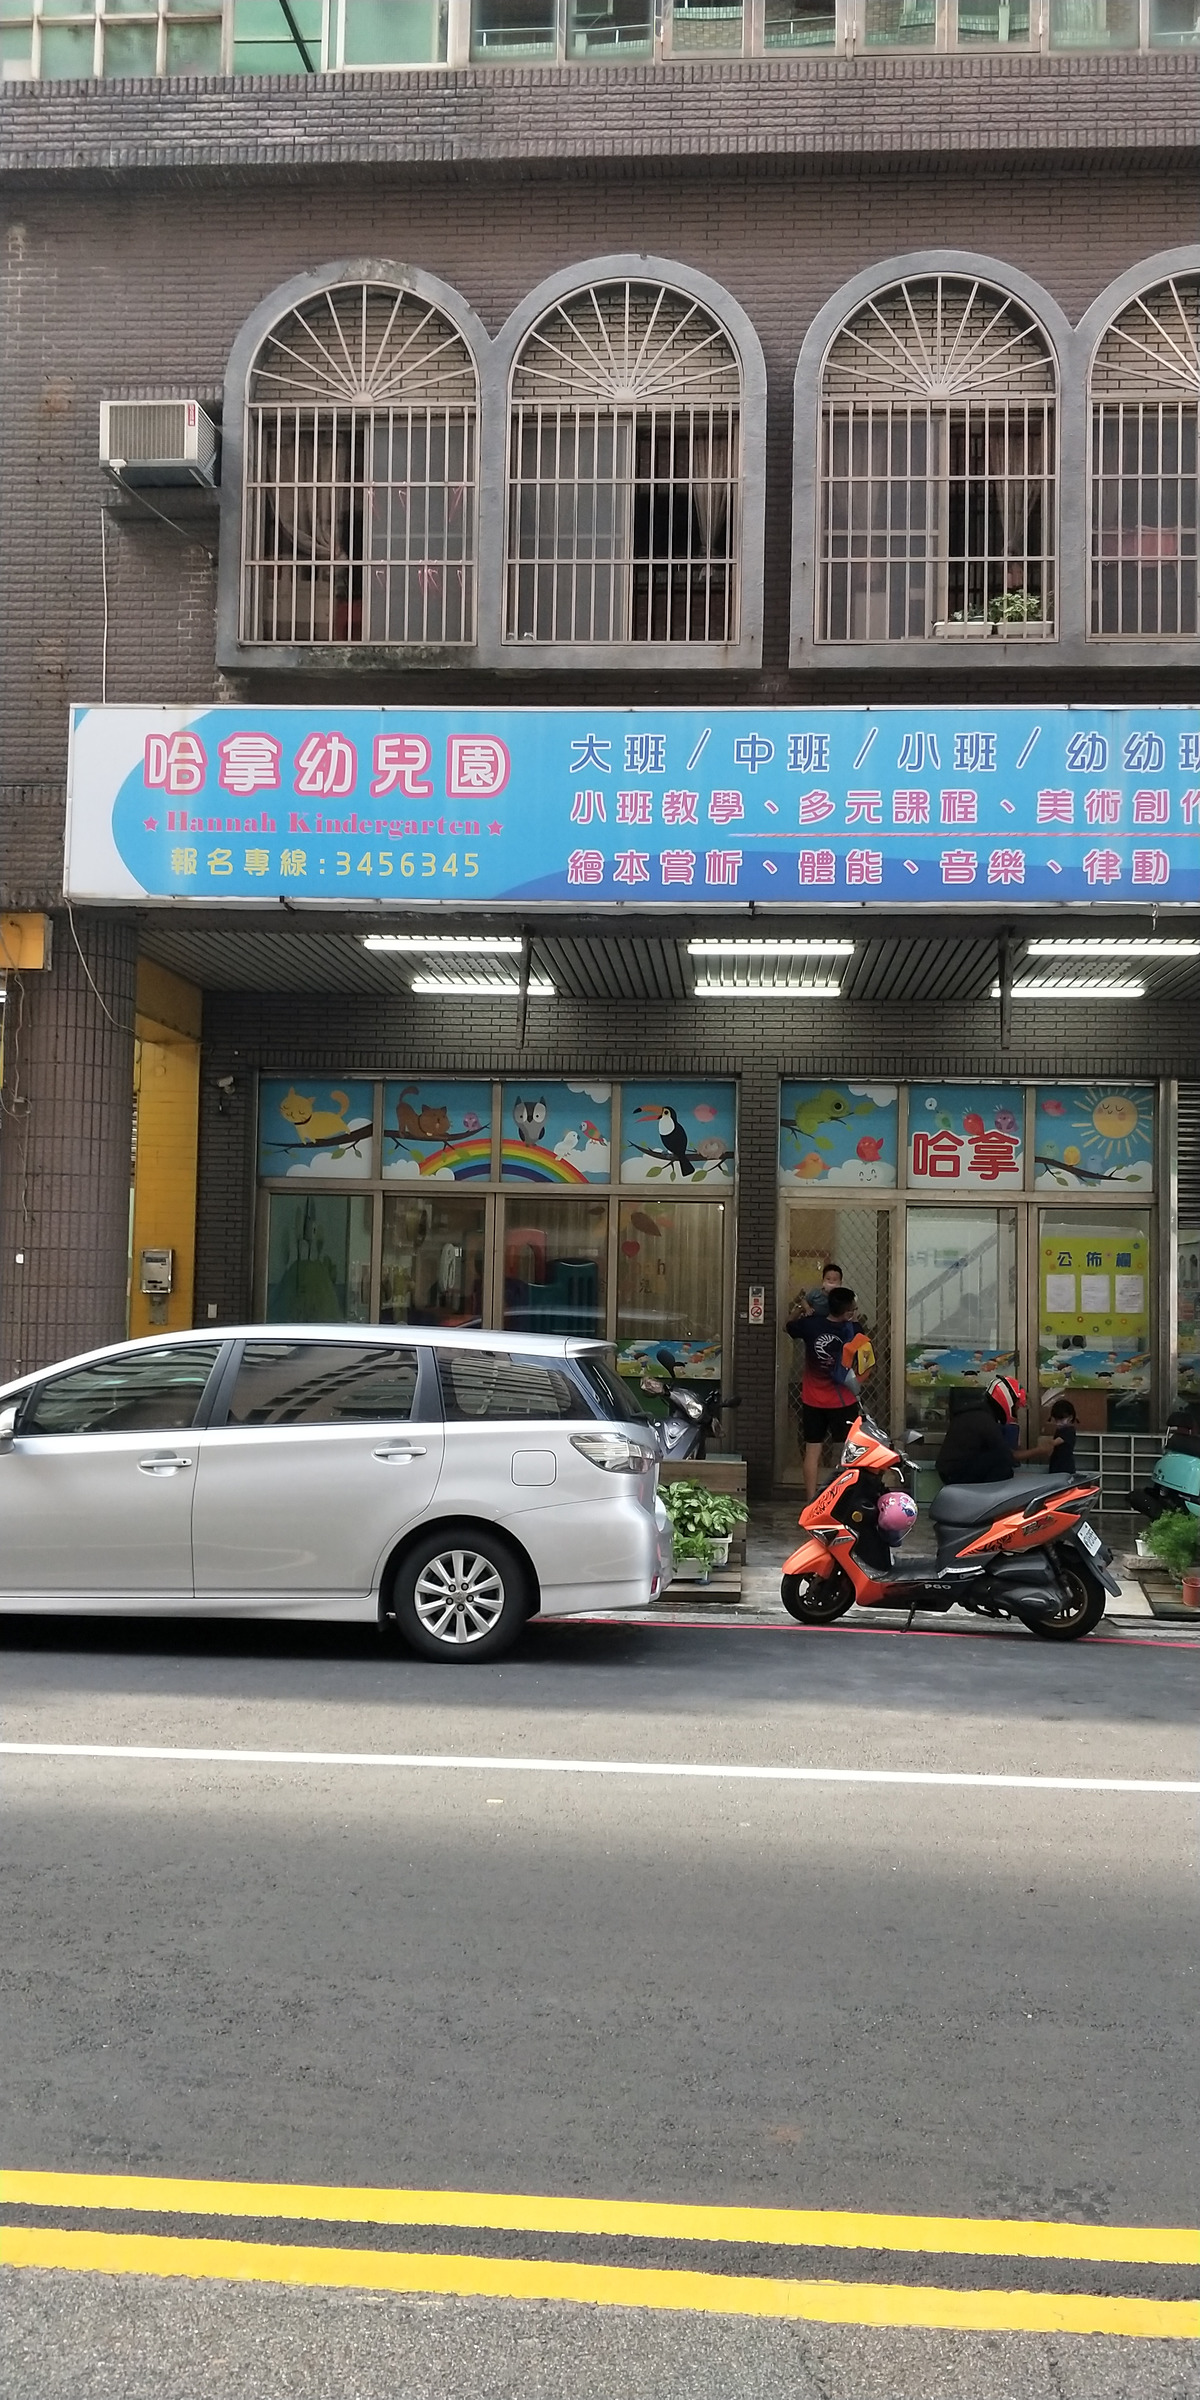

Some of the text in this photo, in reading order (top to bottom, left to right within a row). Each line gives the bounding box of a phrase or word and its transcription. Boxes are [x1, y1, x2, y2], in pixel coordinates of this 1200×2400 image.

[144, 731, 511, 798] 哈拿幼兒園
[166, 811, 481, 841] Hannah Kindergarten
[912, 1130, 1021, 1181] 哈拿
